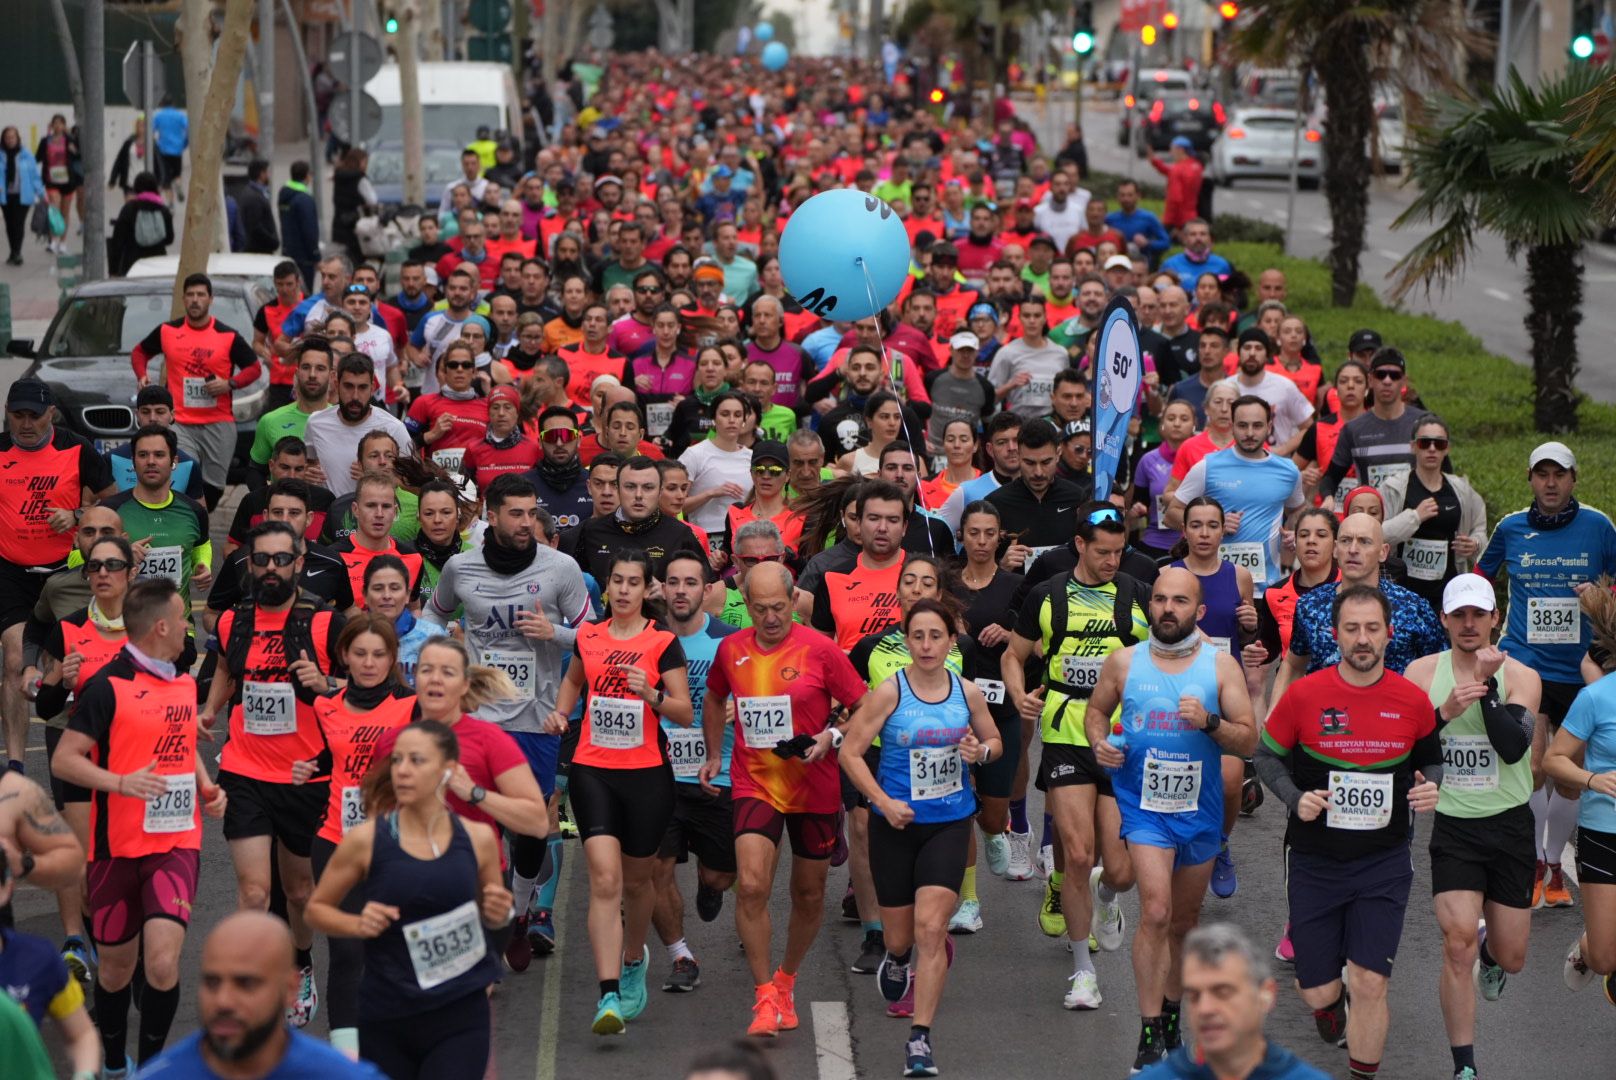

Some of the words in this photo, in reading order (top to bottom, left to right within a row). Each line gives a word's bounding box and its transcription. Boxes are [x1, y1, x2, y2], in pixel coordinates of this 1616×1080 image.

[1113, 352, 1132, 379] 50'
[27, 475, 59, 491] RUN
[31, 491, 46, 500] FOR
[19, 499, 52, 515] LIFE
[1407, 548, 1442, 565] 4007
[139, 557, 176, 574] 2542
[873, 608, 892, 617] FOR
[1532, 609, 1574, 626] 3834
[859, 617, 896, 634] LIFE
[1536, 625, 1570, 633] MADURGA
[265, 655, 284, 666] FOR
[603, 650, 643, 665] RUN
[593, 675, 627, 693] LIFE
[1067, 668, 1098, 685] 298
[246, 695, 286, 714] 3421
[164, 704, 192, 723] RUN
[255, 714, 276, 722] DAVID
[594, 710, 636, 730] 3843
[743, 709, 785, 728] 3712
[598, 728, 630, 737] CRISTINA
[153, 734, 186, 755] LIFE
[353, 743, 373, 754] FOR
[1334, 740, 1364, 748] KENYAN
[1366, 740, 1390, 748] URBAN
[158, 754, 184, 762] FACSA
[1158, 750, 1190, 762] Blumaq
[1441, 749, 1490, 768] 4005
[916, 756, 957, 780] 3145
[1456, 768, 1477, 776] JOSE
[932, 777, 947, 786] ANA
[1148, 773, 1194, 793] 3173
[151, 788, 191, 811] 3788
[1153, 791, 1188, 800] PACHECO
[1335, 786, 1385, 809] 3669
[416, 922, 473, 962] 3633
